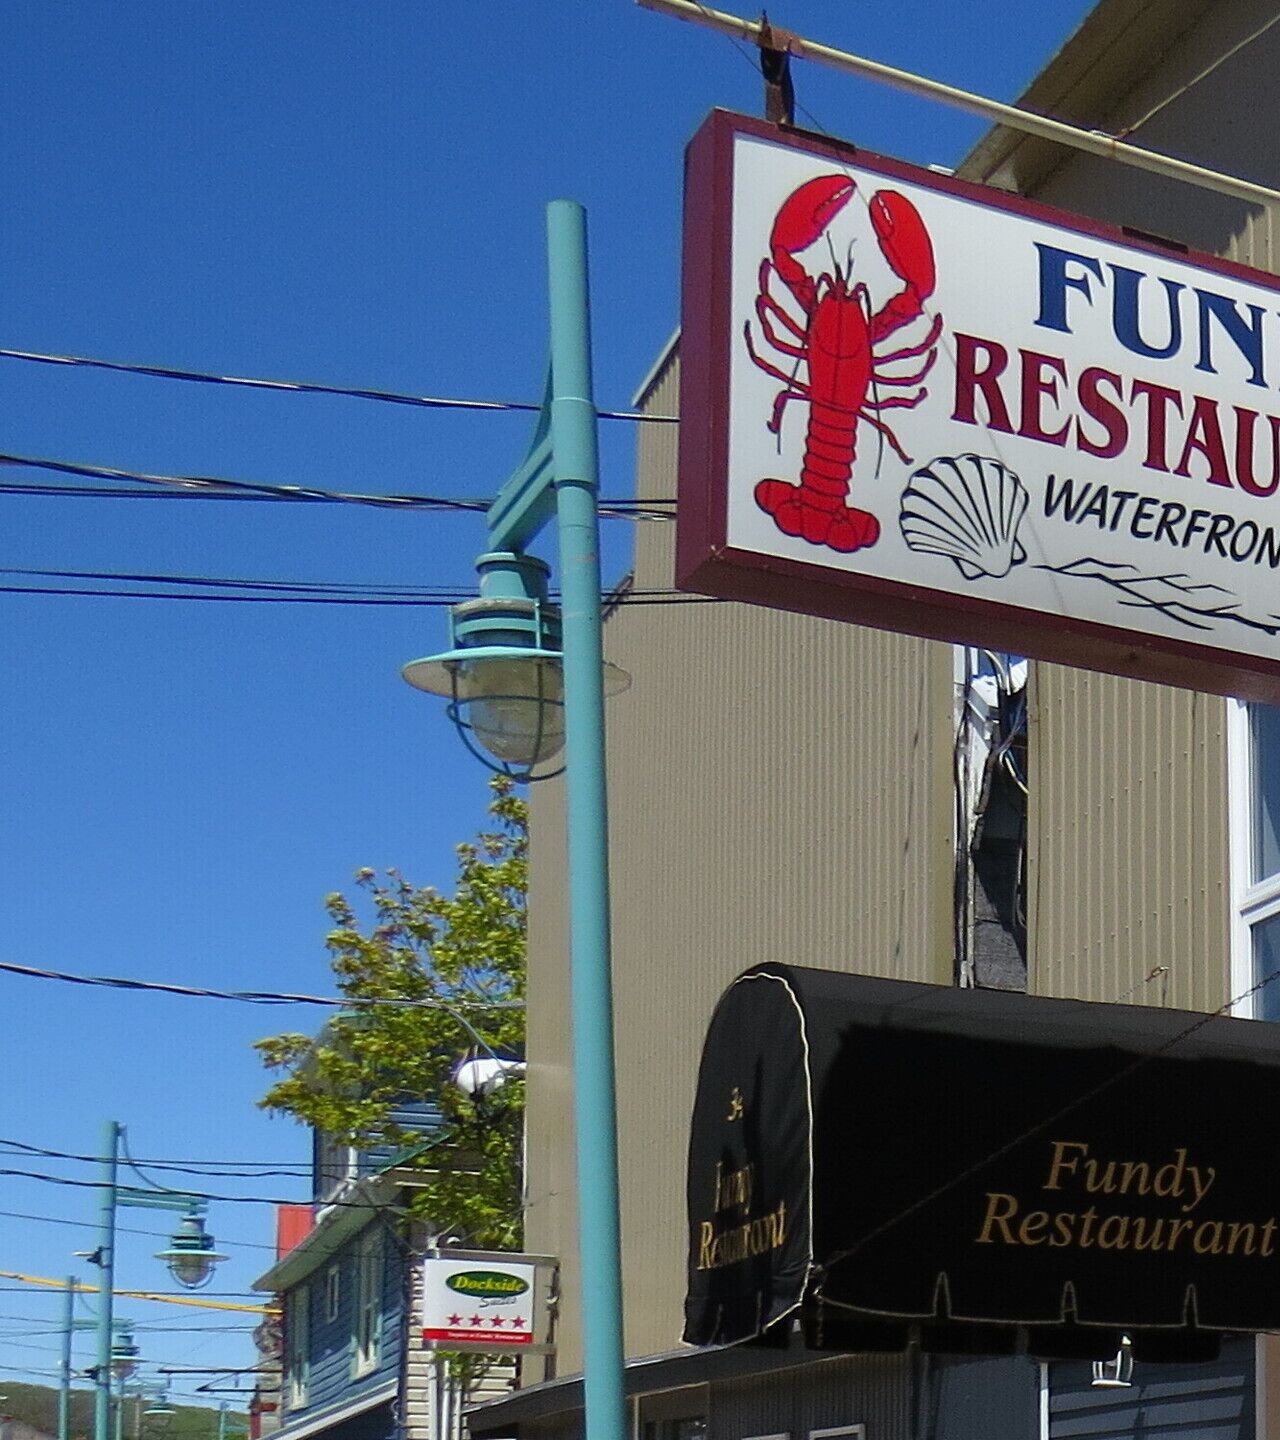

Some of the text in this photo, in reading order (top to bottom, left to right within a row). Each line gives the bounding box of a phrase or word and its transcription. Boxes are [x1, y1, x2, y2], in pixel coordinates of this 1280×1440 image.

[1041, 1141, 1215, 1202] Fundy
[974, 1192, 1278, 1258] Restaurant
[454, 1276, 525, 1292] Dockside
